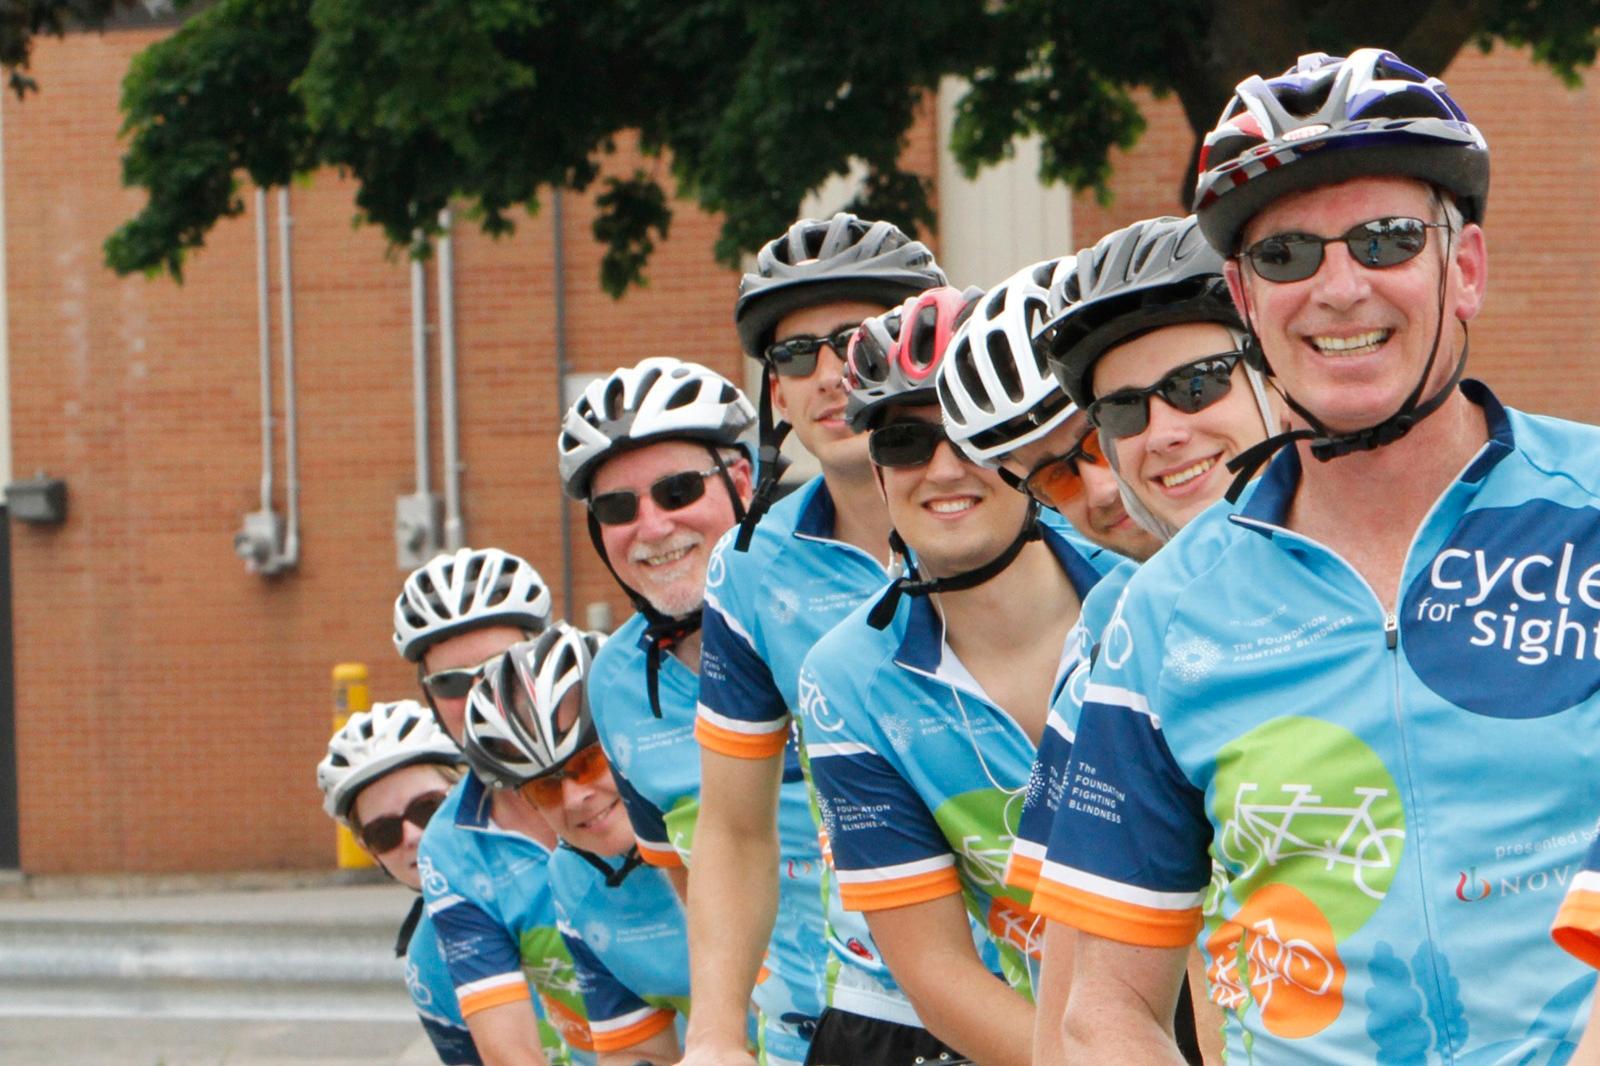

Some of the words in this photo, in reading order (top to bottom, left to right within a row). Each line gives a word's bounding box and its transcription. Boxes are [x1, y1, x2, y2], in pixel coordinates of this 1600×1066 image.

[1417, 597, 1460, 622] for
[1232, 644, 1291, 663] FIGHTING
[1296, 614, 1354, 648] BLINDNESS
[1256, 614, 1328, 646] FOUNDATION
[1078, 761, 1097, 776] The
[1071, 786, 1117, 809] FIGHTING
[1068, 799, 1121, 824] BLINDNESS
[1496, 832, 1577, 860] presented
[1501, 864, 1571, 897] NOV
